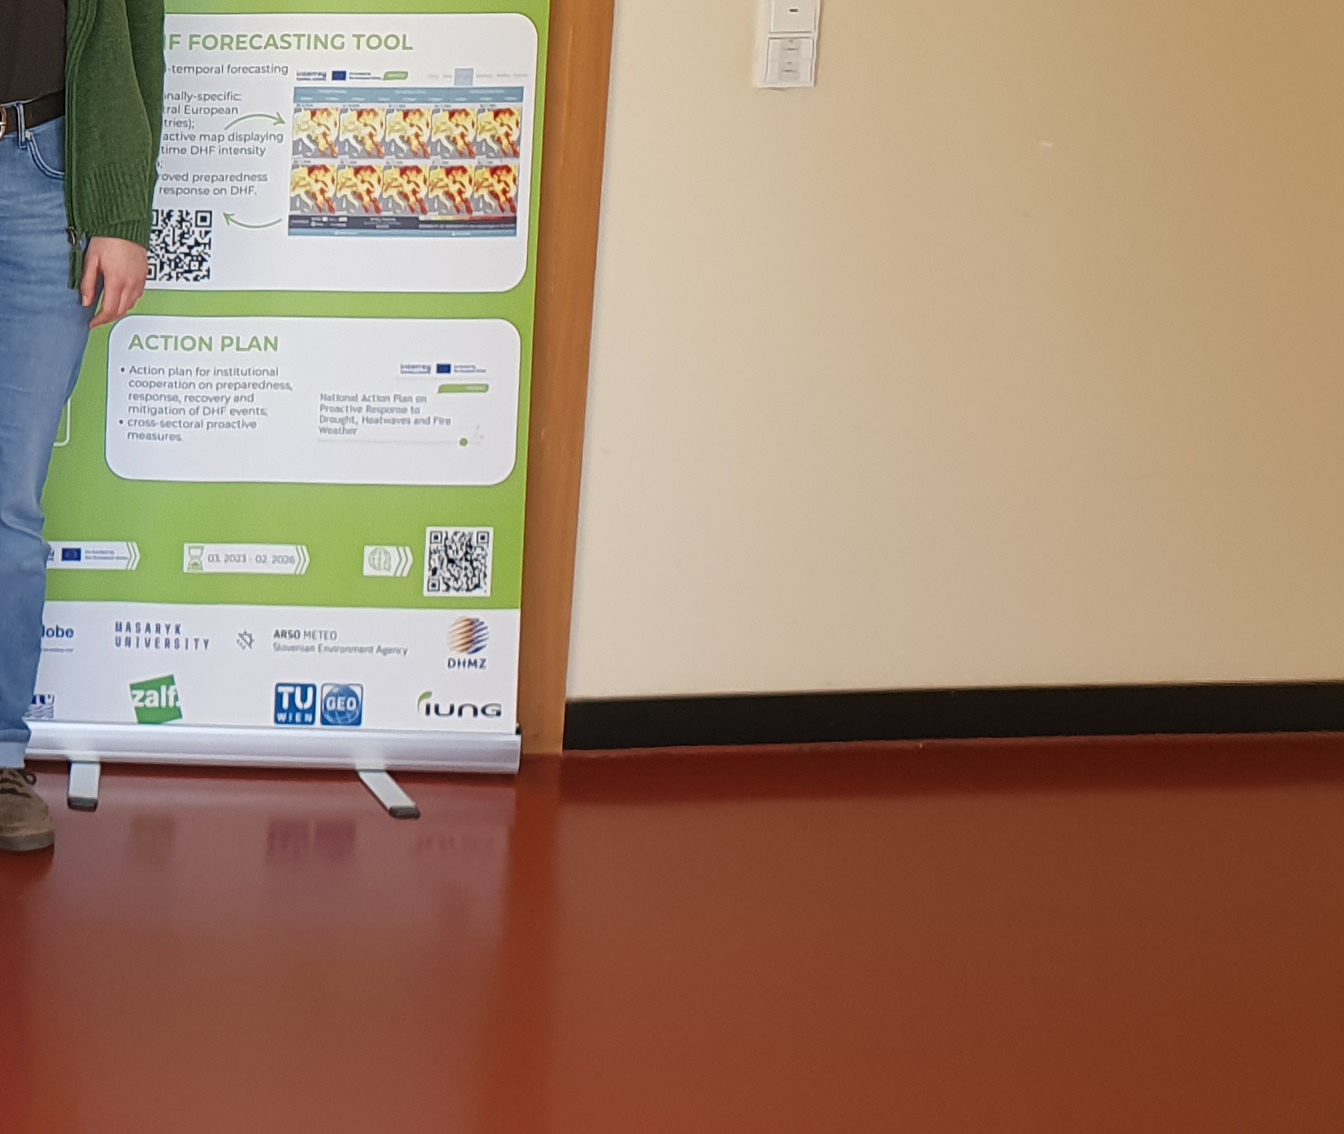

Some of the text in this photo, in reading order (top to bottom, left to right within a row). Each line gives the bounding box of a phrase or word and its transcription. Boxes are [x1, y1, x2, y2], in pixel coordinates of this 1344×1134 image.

[188, 33, 346, 51] FORECASTING
[352, 34, 414, 50] TOOL
[227, 64, 288, 75] forecasting
[184, 105, 239, 116] European
[163, 132, 284, 143] active map displaying
[191, 146, 216, 155] DHF
[218, 146, 266, 157] intensity
[192, 172, 268, 183] preparedness
[159, 186, 257, 196] response on DHF.
[128, 333, 279, 353] ACTION PLAN
[129, 366, 279, 378] Action plan for institutional
[128, 379, 196, 390] cooperation
[198, 381, 212, 389] on
[128, 392, 254, 405] response, recovery and
[128, 405, 185, 416] mitigation
[189, 406, 201, 415] of
[202, 407, 226, 416] DHF
[206, 419, 257, 431] proactive
[115, 621, 182, 634] MASARYK
[273, 629, 337, 640] ARSO METEO
[115, 636, 210, 650] UNIVERSITY
[448, 658, 487, 669] DHMZ
[277, 686, 313, 710] TU
[326, 696, 357, 711] GEO
